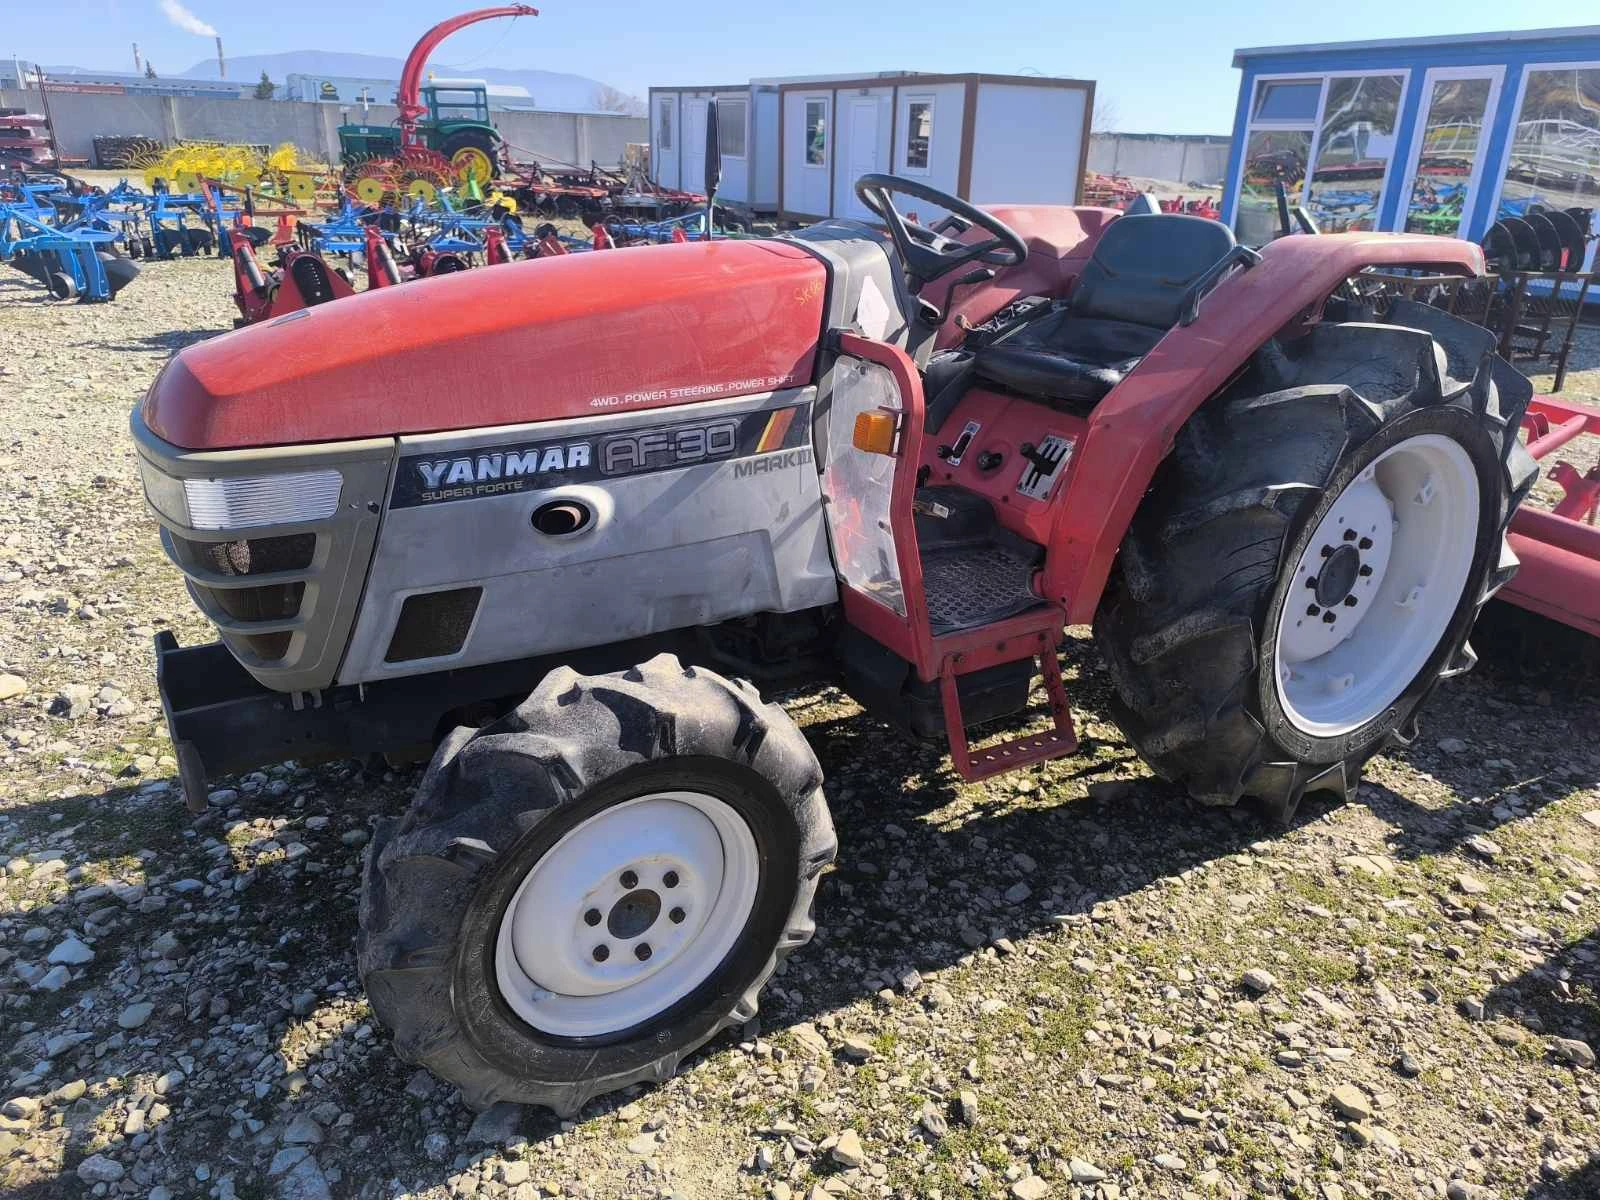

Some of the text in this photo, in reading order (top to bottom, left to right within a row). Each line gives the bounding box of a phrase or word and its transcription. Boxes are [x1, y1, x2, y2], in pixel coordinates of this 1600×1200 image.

[767, 375, 793, 386] SHIFT
[418, 441, 592, 489] YANMAR
[422, 481, 524, 501] SUPER FORTE
